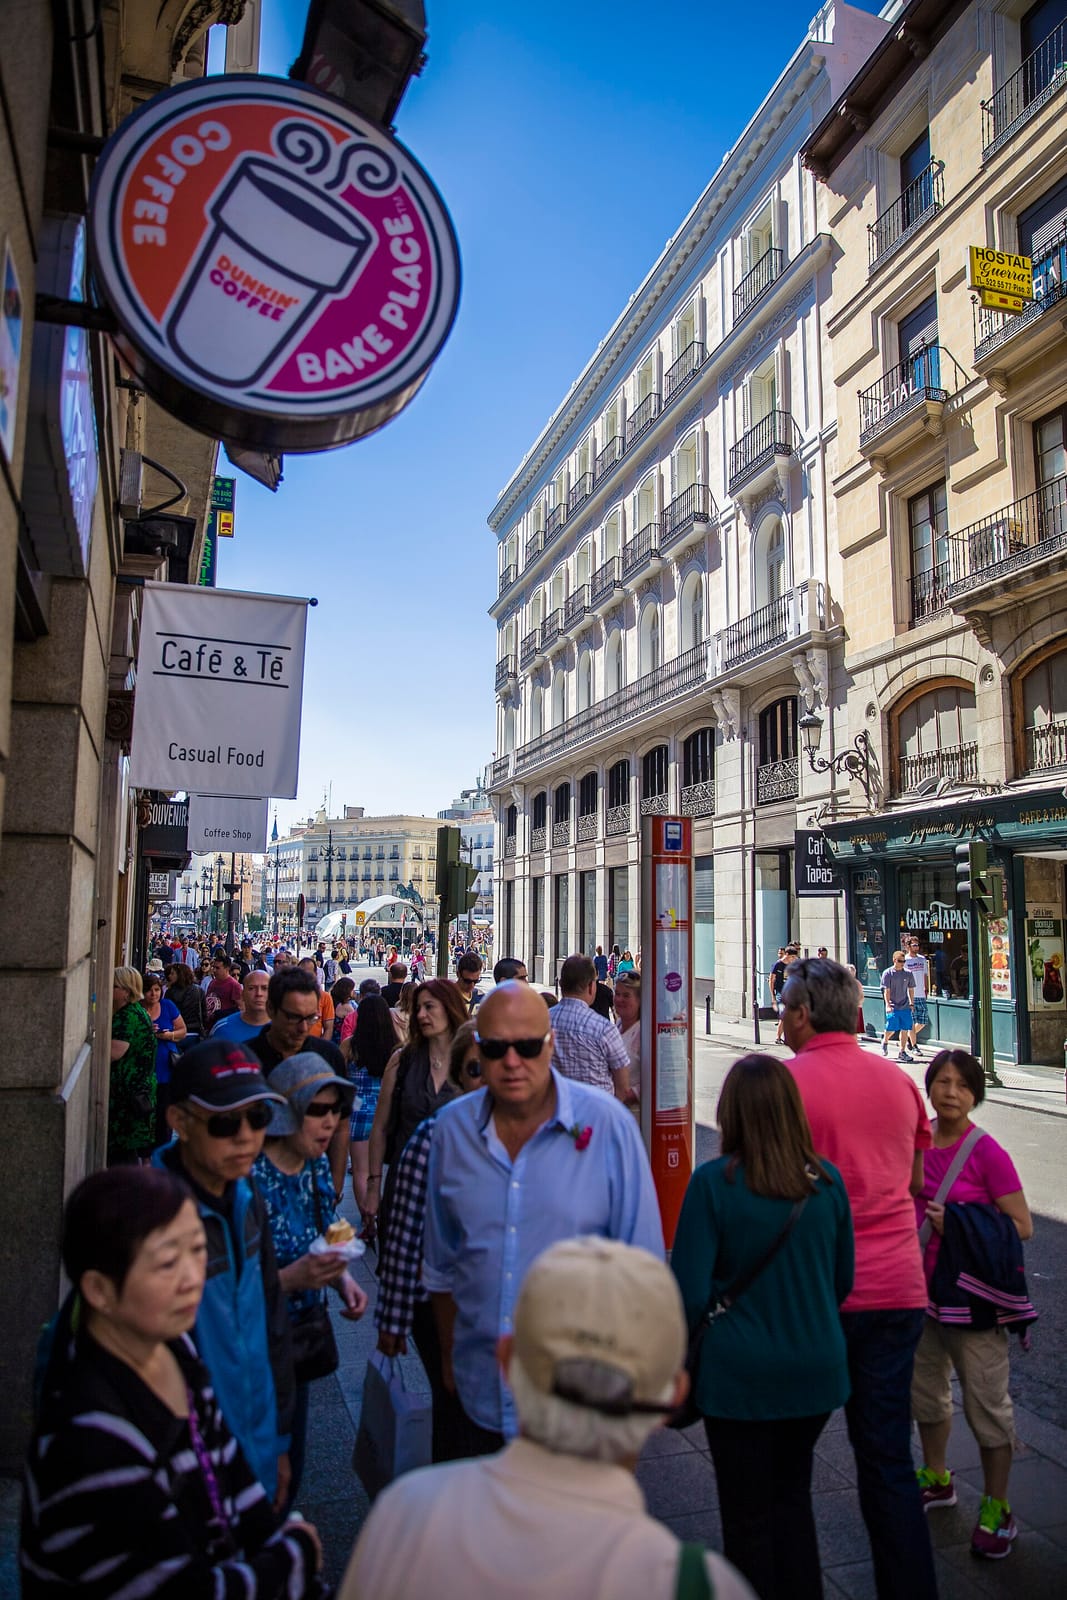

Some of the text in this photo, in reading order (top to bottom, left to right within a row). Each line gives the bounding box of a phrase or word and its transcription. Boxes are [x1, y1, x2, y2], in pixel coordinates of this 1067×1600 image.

[133, 121, 231, 247] COFFEE
[975, 248, 1030, 270] HOSTAL
[217, 255, 300, 308] DUNKIN'
[979, 262, 1026, 282] Guerra
[986, 278, 996, 287] 522
[209, 269, 286, 322] COFFEE
[296, 323, 393, 384] BAKE
[383, 215, 423, 330] PLACE
[233, 656, 248, 677] &
[168, 742, 265, 768] Casual Food
[1019, 810, 1042, 825] CAFE
[1049, 806, 1067, 820] TAP
[204, 828, 252, 841] Coffee Shop
[808, 836, 824, 855] Caf
[806, 865, 832, 883] Tapas
[906, 908, 930, 929] CAFE
[930, 901, 968, 929] TAPAS
